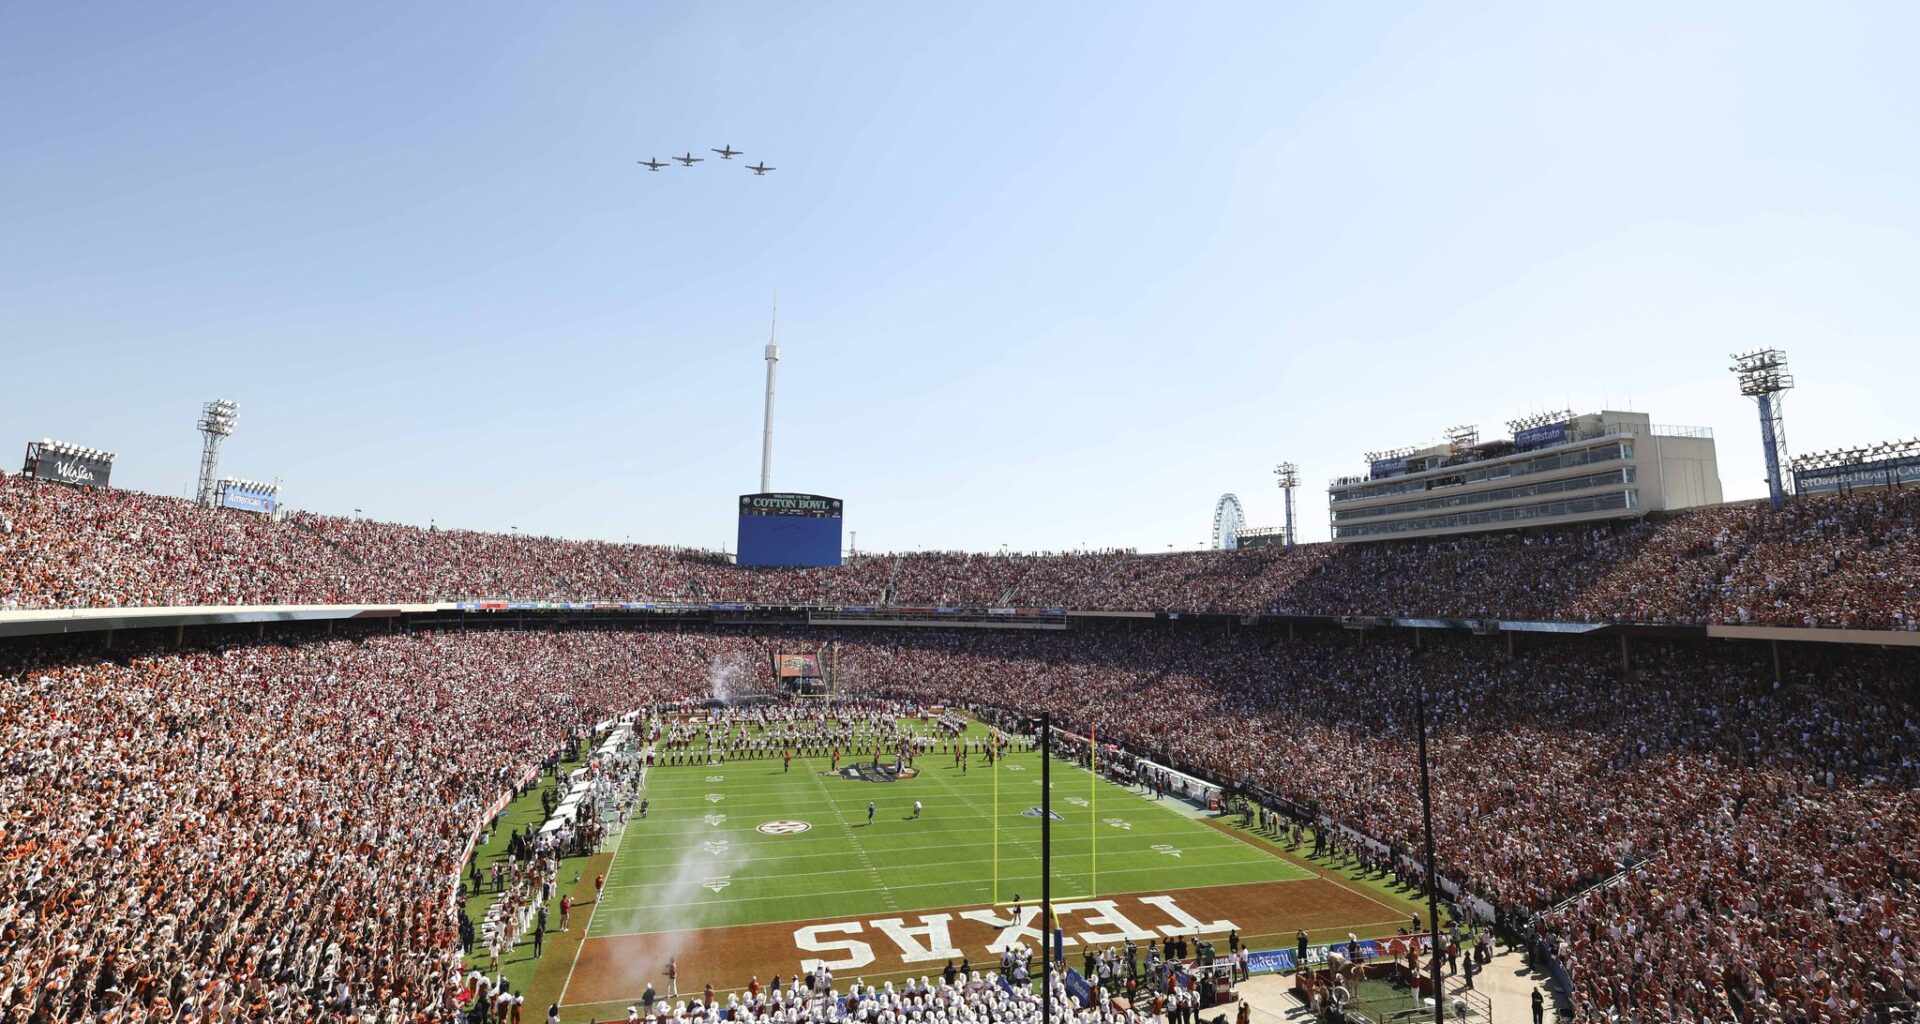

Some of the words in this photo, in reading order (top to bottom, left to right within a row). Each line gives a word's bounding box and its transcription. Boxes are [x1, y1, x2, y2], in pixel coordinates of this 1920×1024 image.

[53, 455, 95, 482] WinStar
[753, 498, 796, 508] COTTON
[799, 500, 830, 510] BOWL
[793, 895, 1241, 974] TEXAS
